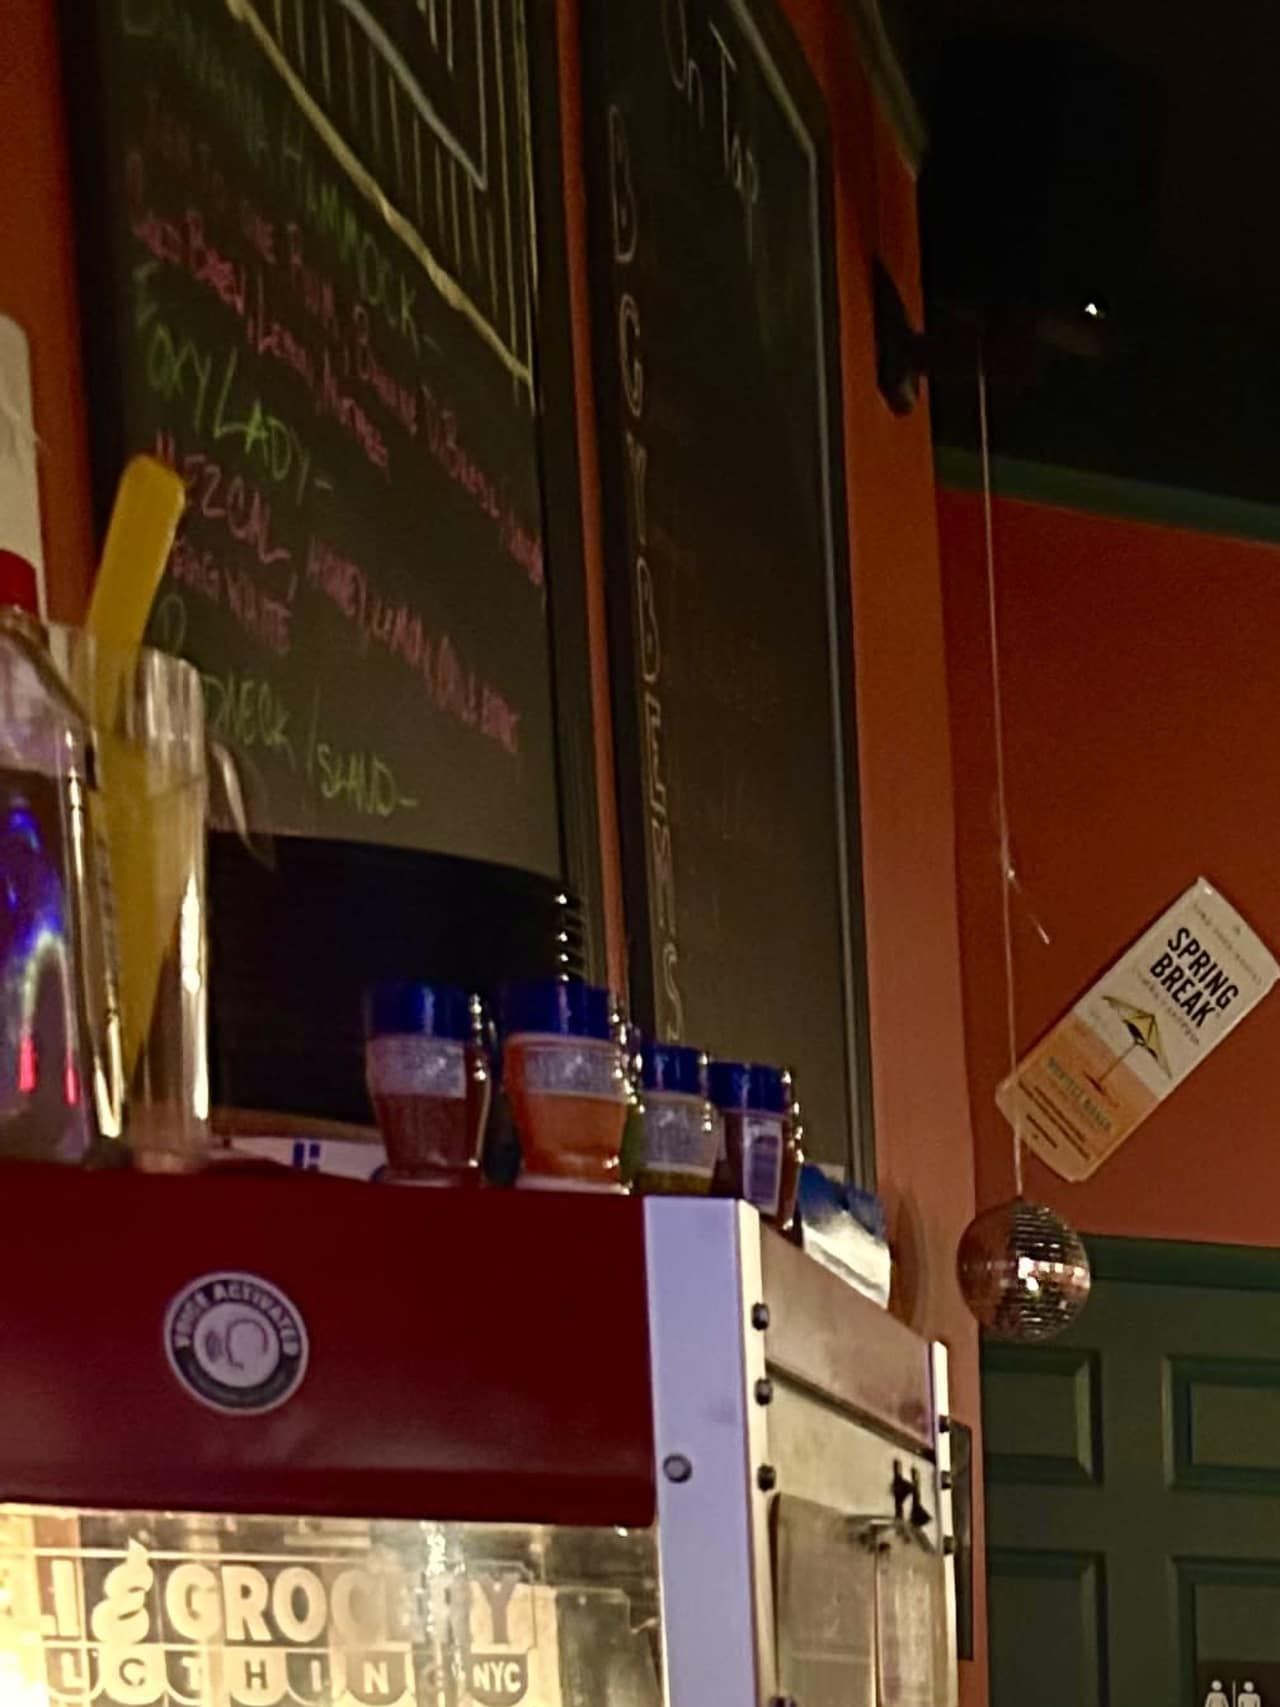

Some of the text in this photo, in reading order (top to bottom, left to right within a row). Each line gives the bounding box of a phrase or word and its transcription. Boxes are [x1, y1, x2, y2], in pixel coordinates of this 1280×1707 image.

[1149, 954, 1217, 1030] BREAK
[1167, 927, 1239, 1010] SPRING
[212, 1280, 301, 1357] ACTIVATED
[166, 1563, 518, 1648] GROCERY
[473, 1659, 523, 1691] NYC
